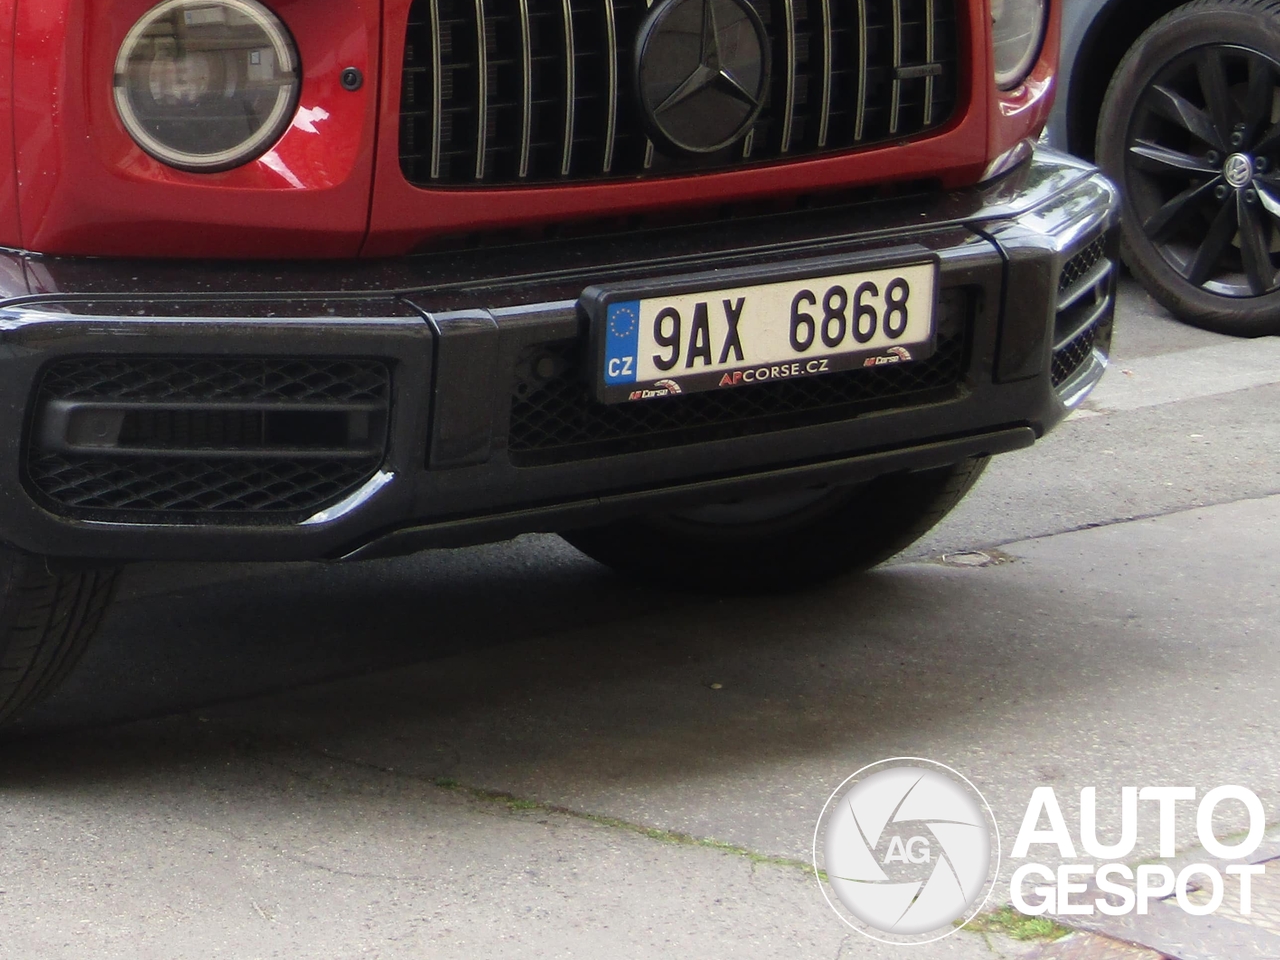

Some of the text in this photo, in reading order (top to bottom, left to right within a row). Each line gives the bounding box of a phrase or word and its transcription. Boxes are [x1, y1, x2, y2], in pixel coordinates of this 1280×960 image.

[652, 277, 910, 371] 9AX 6868
[608, 356, 633, 377] CZ
